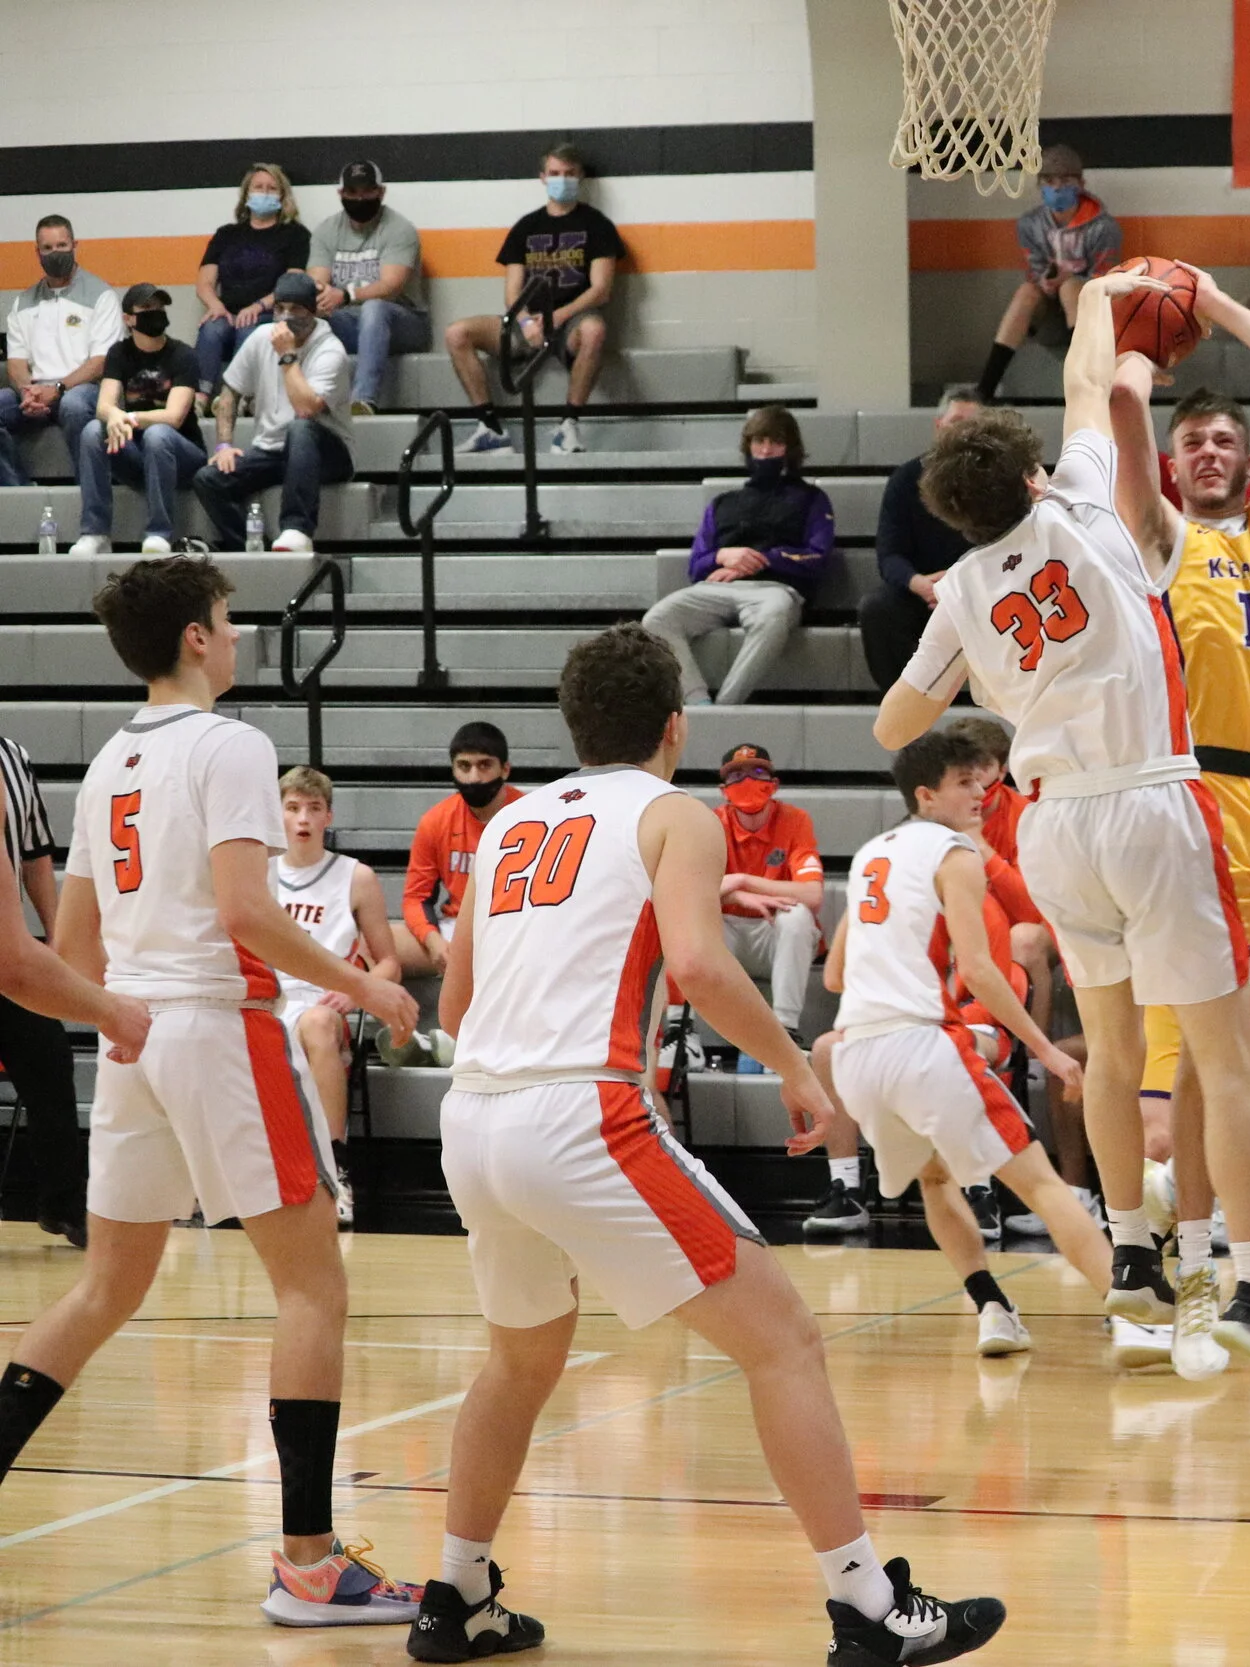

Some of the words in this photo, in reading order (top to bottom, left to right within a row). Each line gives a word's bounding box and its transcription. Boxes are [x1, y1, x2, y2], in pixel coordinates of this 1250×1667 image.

[990, 558, 1090, 672] 33
[110, 788, 143, 894] 5
[488, 813, 597, 918] 20
[858, 856, 892, 925] 3
